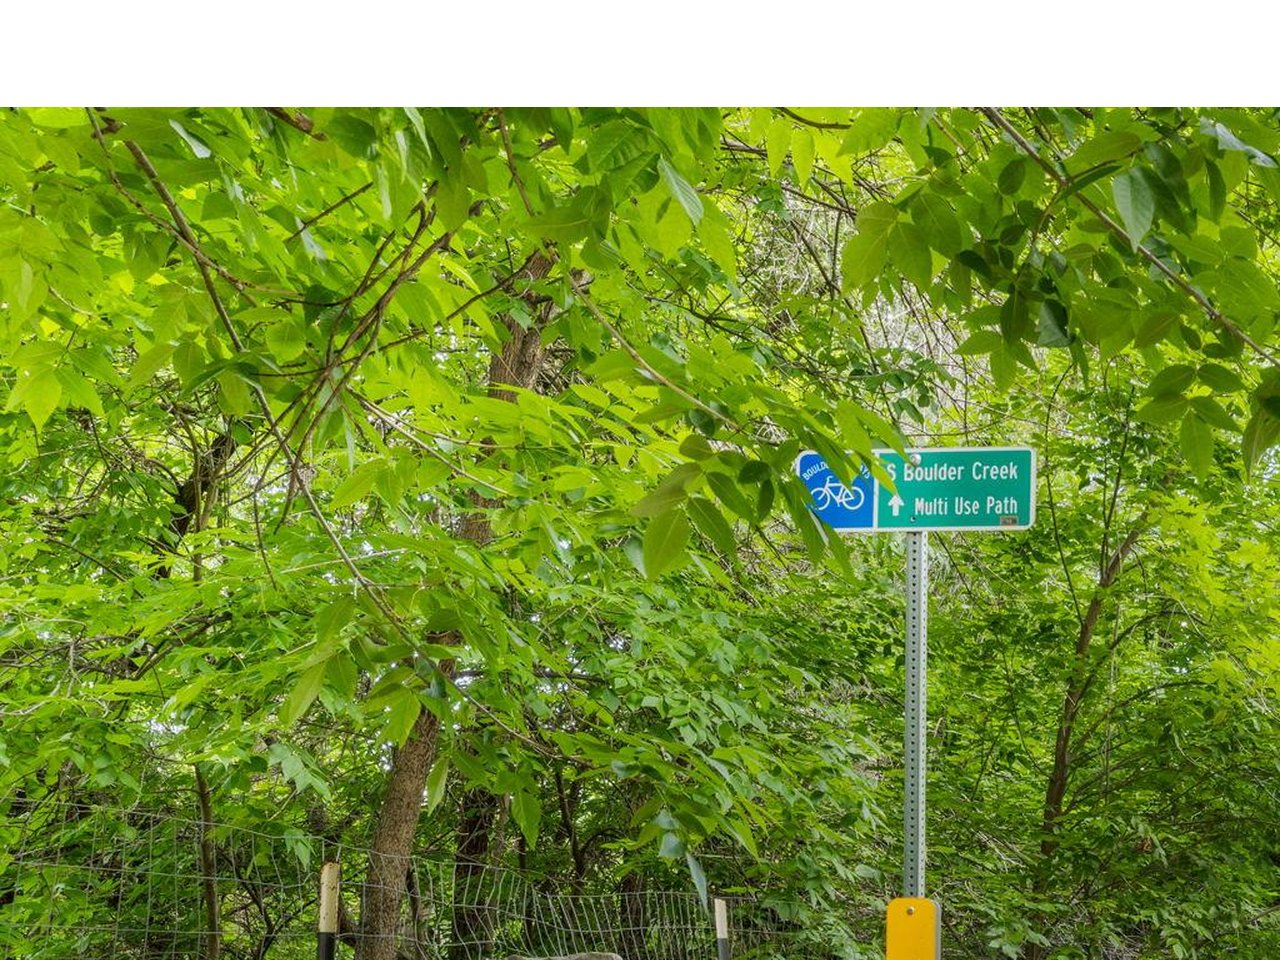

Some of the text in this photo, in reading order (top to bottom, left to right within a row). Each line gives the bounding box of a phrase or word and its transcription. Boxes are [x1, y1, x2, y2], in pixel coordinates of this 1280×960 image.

[887, 463, 896, 481] S
[904, 463, 965, 481] Boulder
[972, 461, 1018, 480] Creek
[915, 496, 1018, 516] Multi Use Path
